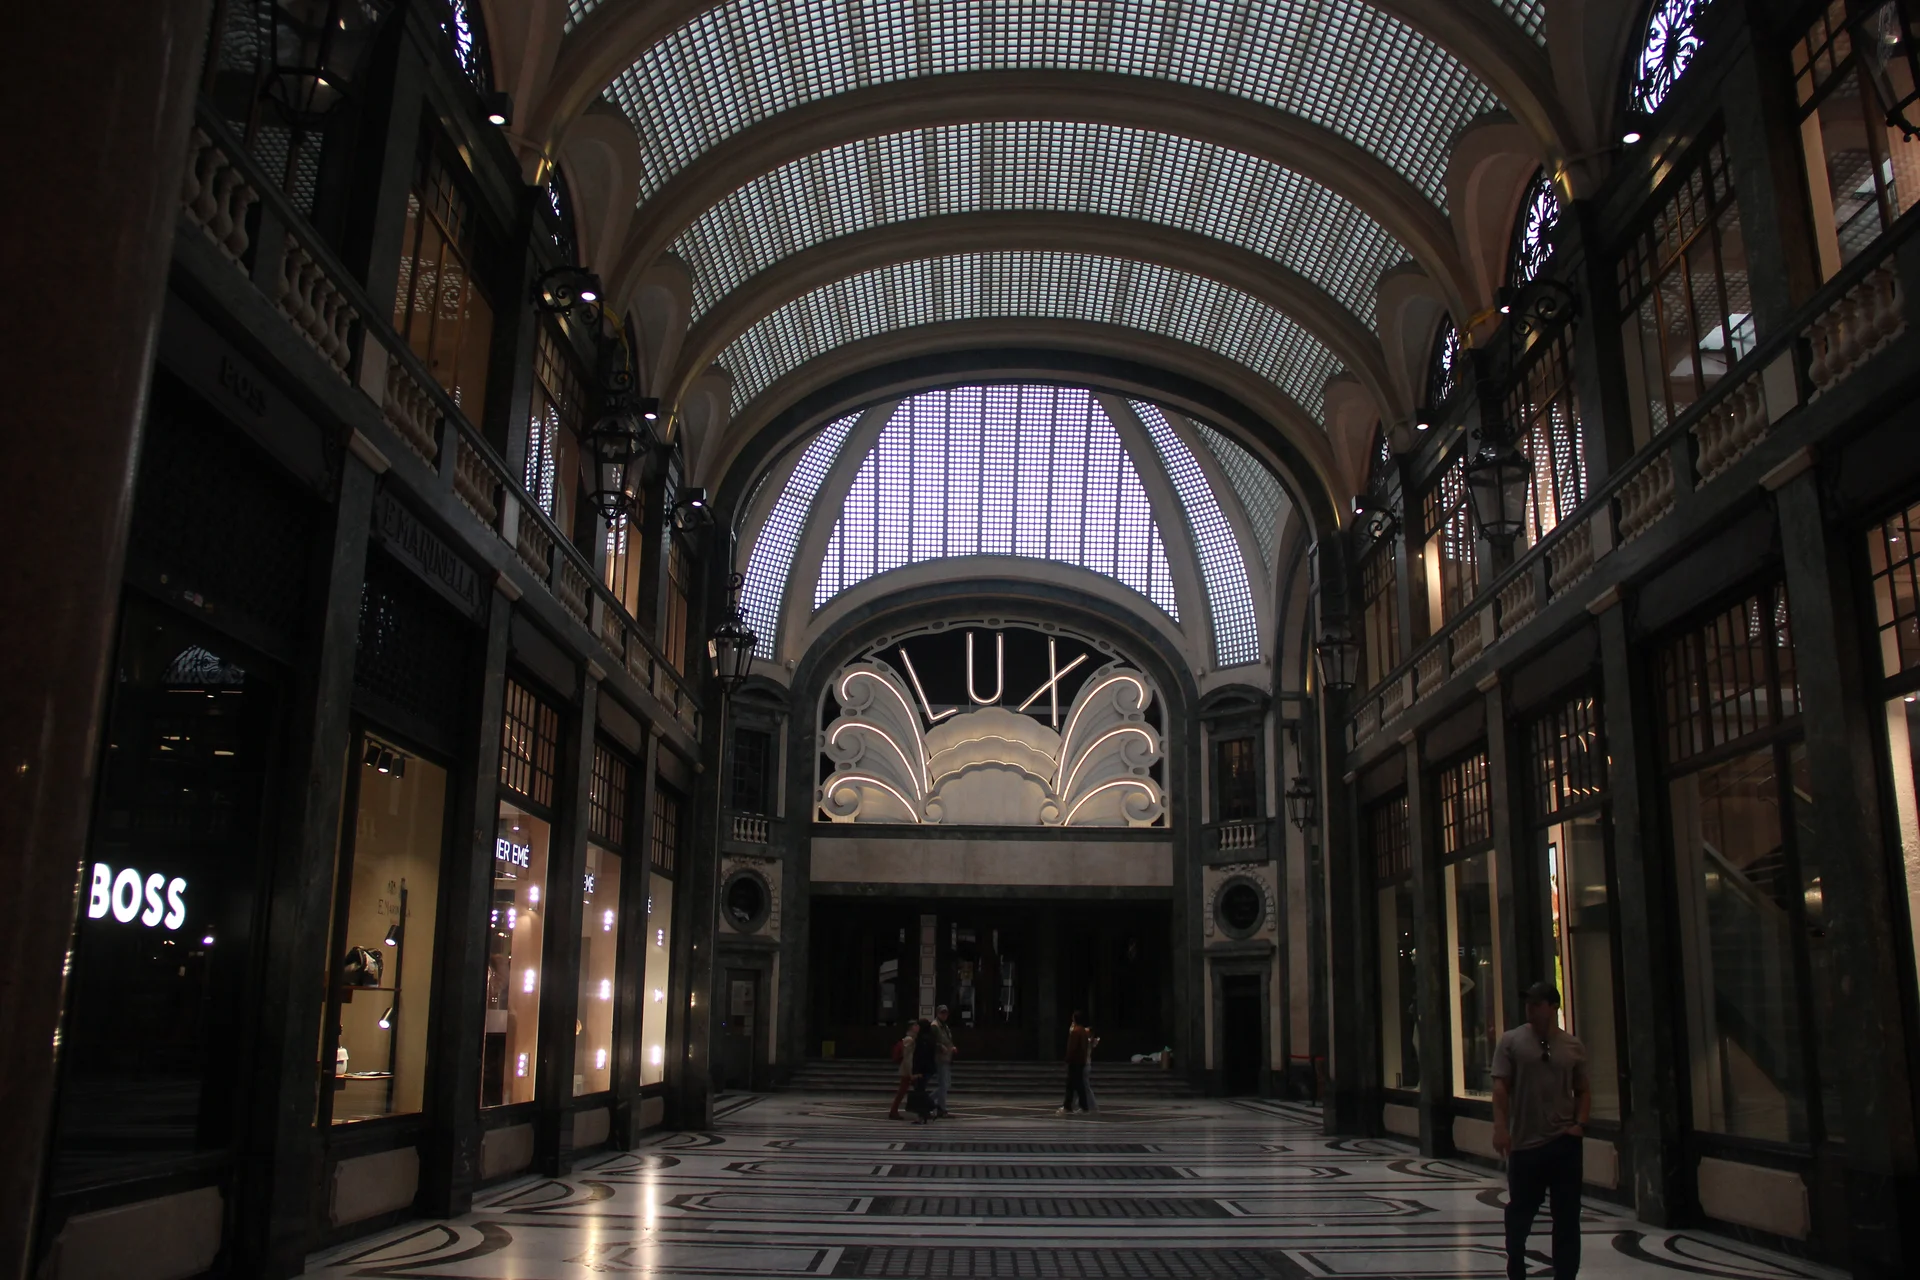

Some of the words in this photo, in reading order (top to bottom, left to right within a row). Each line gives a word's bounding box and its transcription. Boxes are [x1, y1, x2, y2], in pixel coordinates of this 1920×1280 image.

[898, 631, 1089, 730] LUX
[512, 844, 530, 869] EMÉ
[88, 862, 187, 930] BOSS
